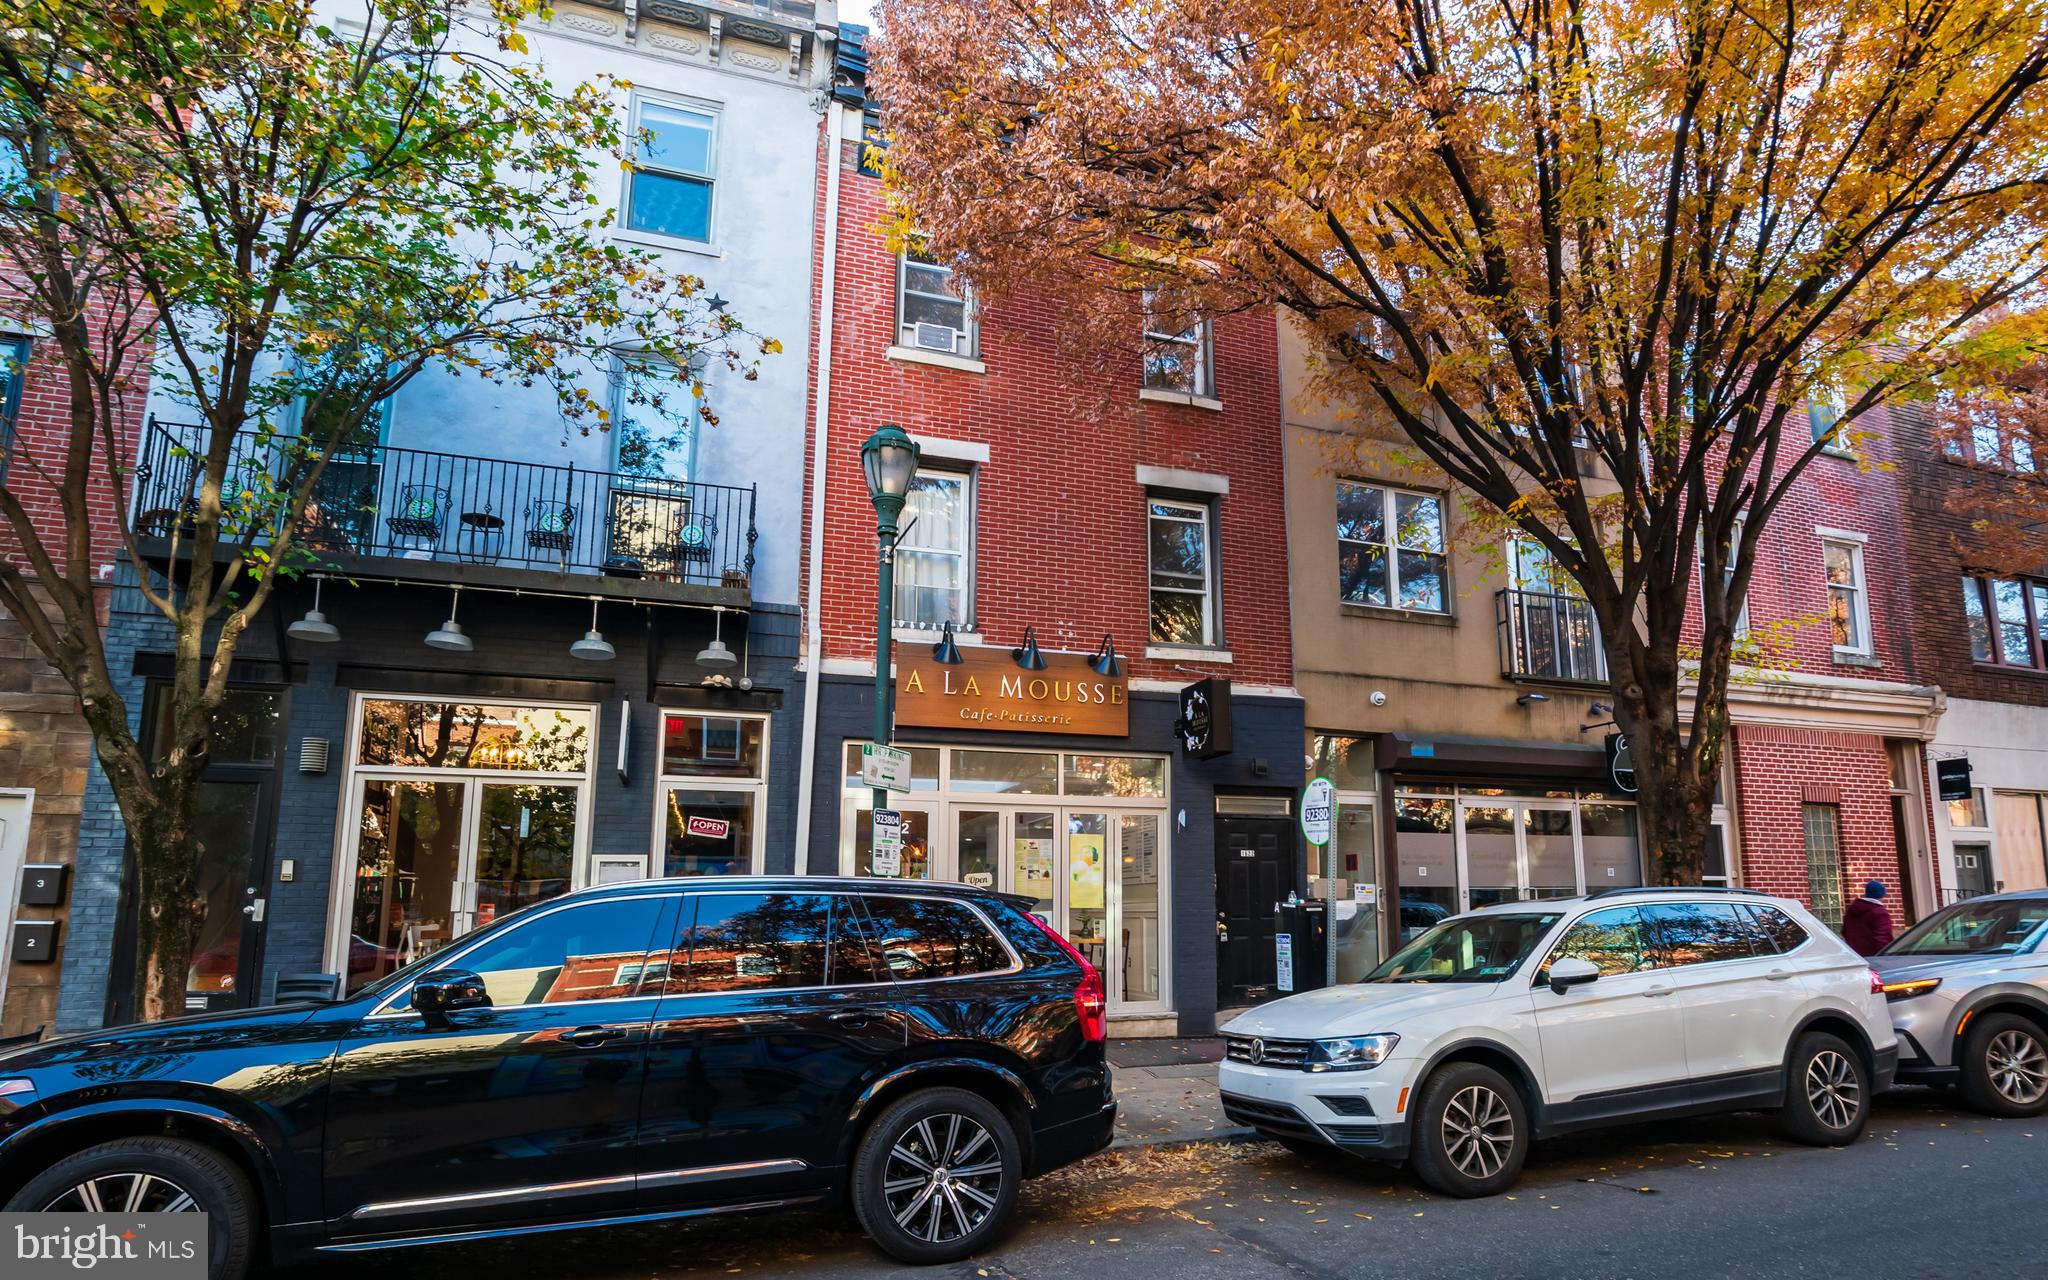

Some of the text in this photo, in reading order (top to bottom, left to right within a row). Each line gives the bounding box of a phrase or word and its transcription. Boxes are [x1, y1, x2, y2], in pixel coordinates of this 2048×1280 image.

[904, 669, 1123, 706] A LA MOUSSE
[876, 814, 899, 825] 923804
[1306, 808, 1330, 822] 92380
[698, 820, 726, 832] OPEN
[36, 879, 45, 888] 3
[968, 875, 988, 886] Open
[26, 938, 36, 947] 2
